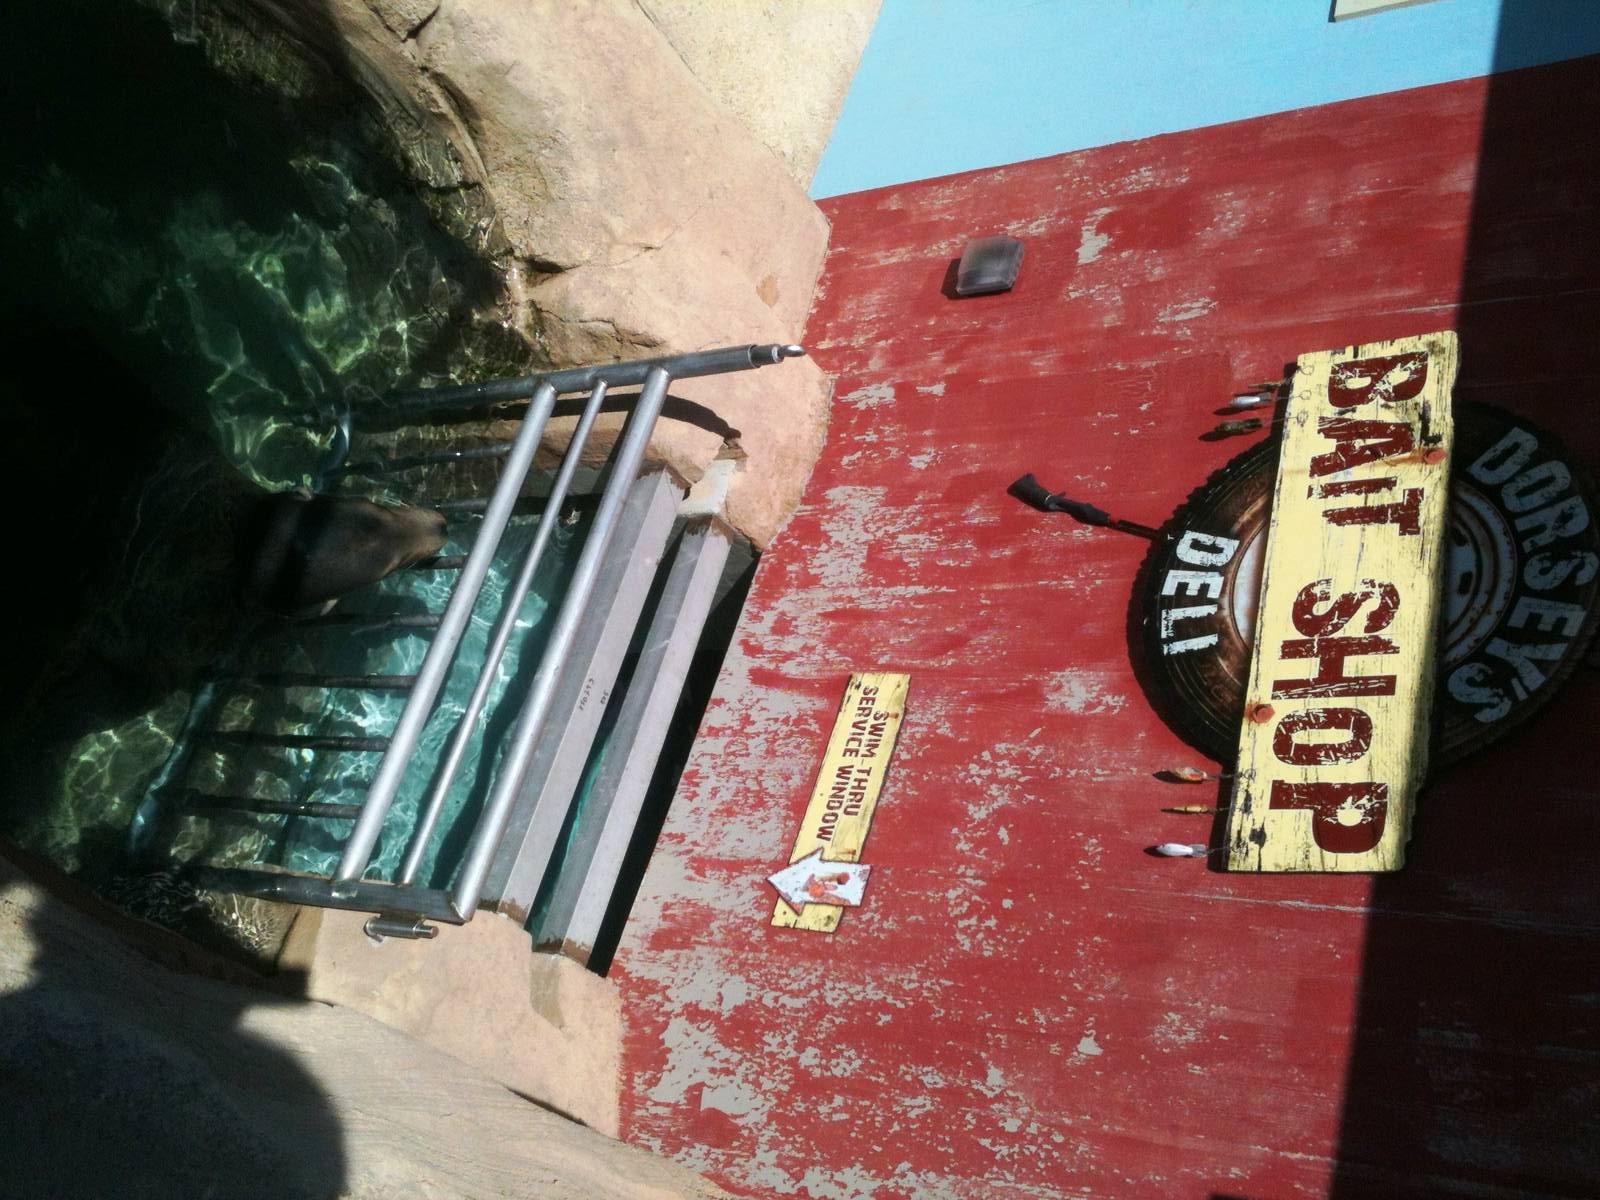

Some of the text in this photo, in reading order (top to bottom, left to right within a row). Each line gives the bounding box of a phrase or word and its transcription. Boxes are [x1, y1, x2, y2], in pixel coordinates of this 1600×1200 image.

[1162, 529, 1241, 656] DELI
[1268, 350, 1429, 854] BAIT SHOP
[816, 685, 879, 842] SERVICE WINDOW
